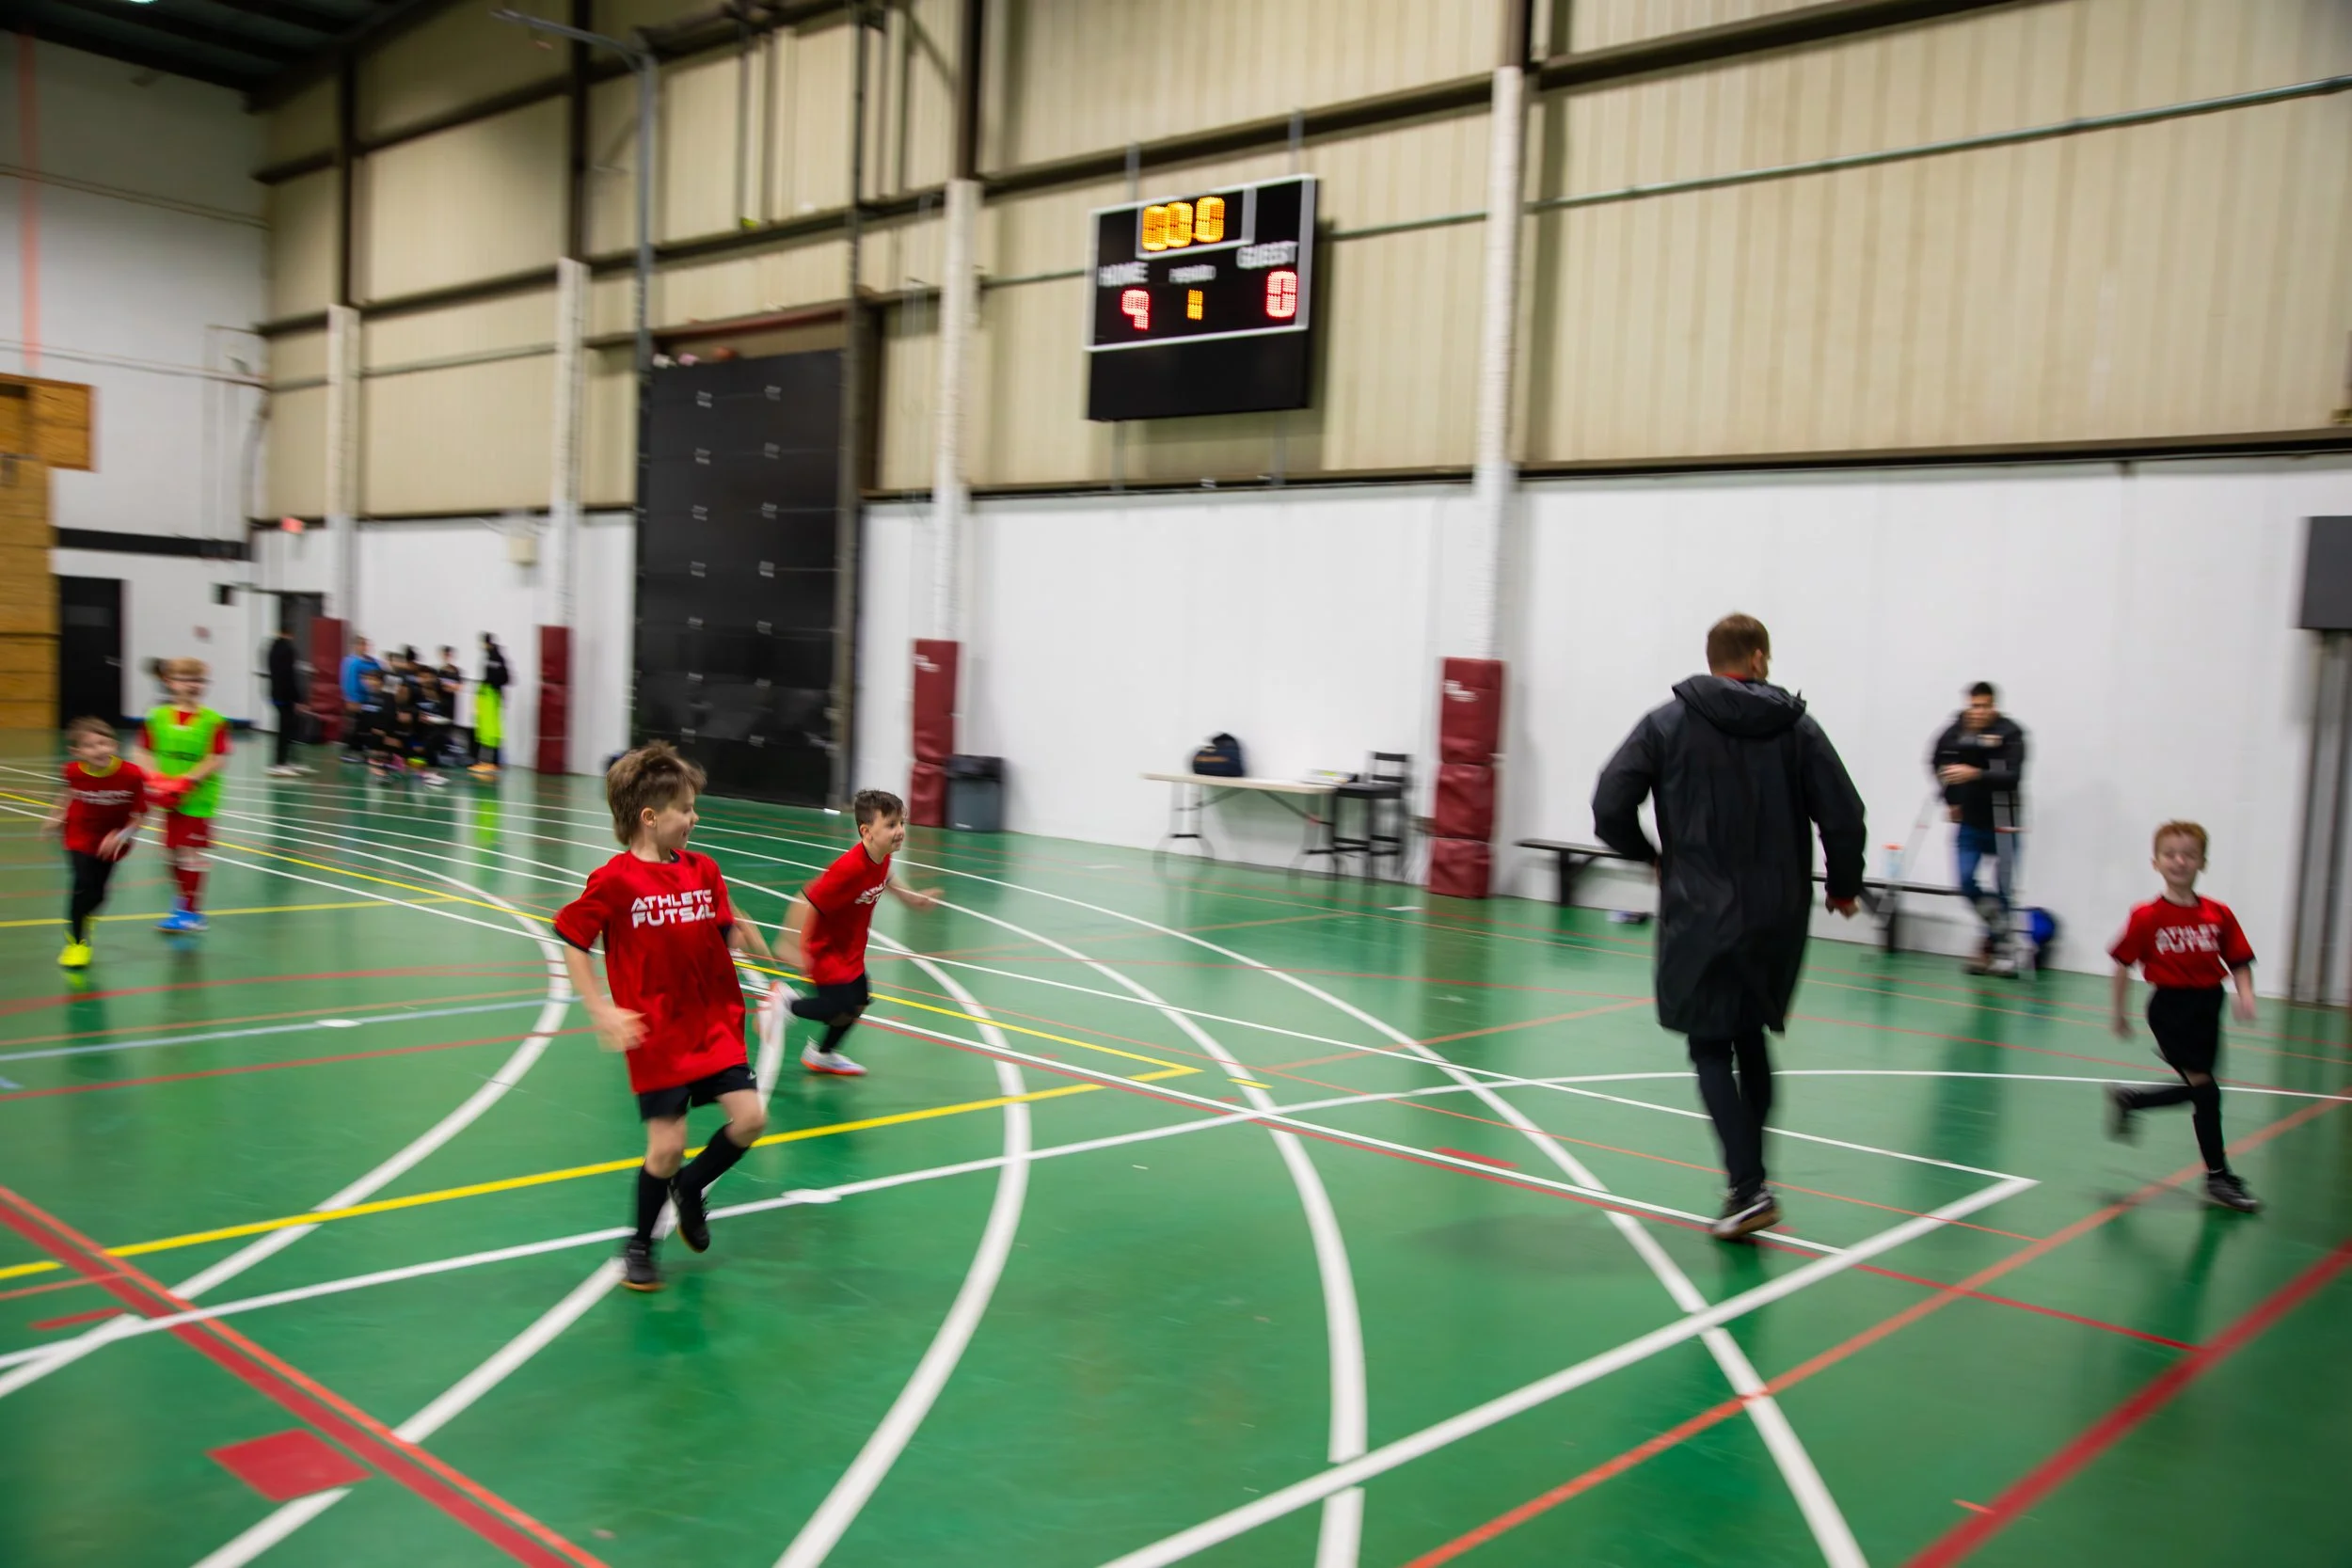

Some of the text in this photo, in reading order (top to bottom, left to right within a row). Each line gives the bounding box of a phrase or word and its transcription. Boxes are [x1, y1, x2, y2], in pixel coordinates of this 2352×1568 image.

[1121, 290, 1149, 329] 9
[1186, 289, 1203, 320] 1
[631, 904, 716, 929] FUTSAL
